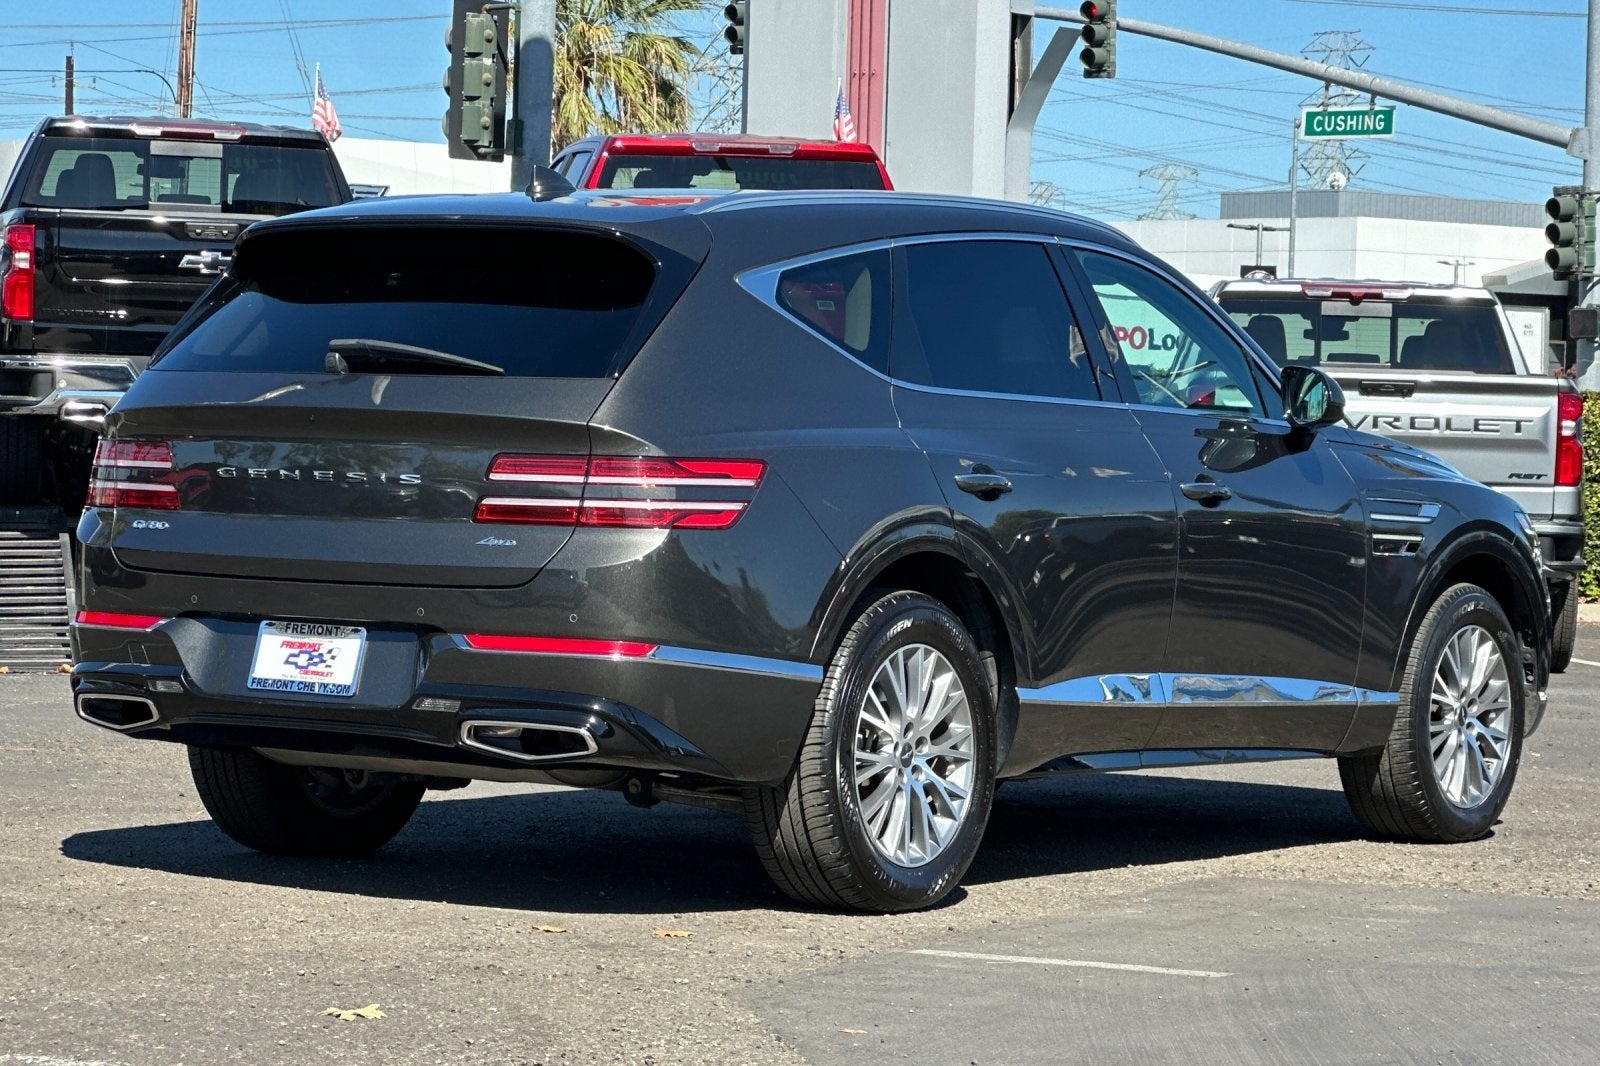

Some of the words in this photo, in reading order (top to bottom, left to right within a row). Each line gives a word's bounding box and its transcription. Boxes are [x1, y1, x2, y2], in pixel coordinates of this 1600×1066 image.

[1313, 114, 1385, 132] CUSHING
[216, 466, 422, 485] GENESIS
[285, 623, 340, 637] FREMONT
